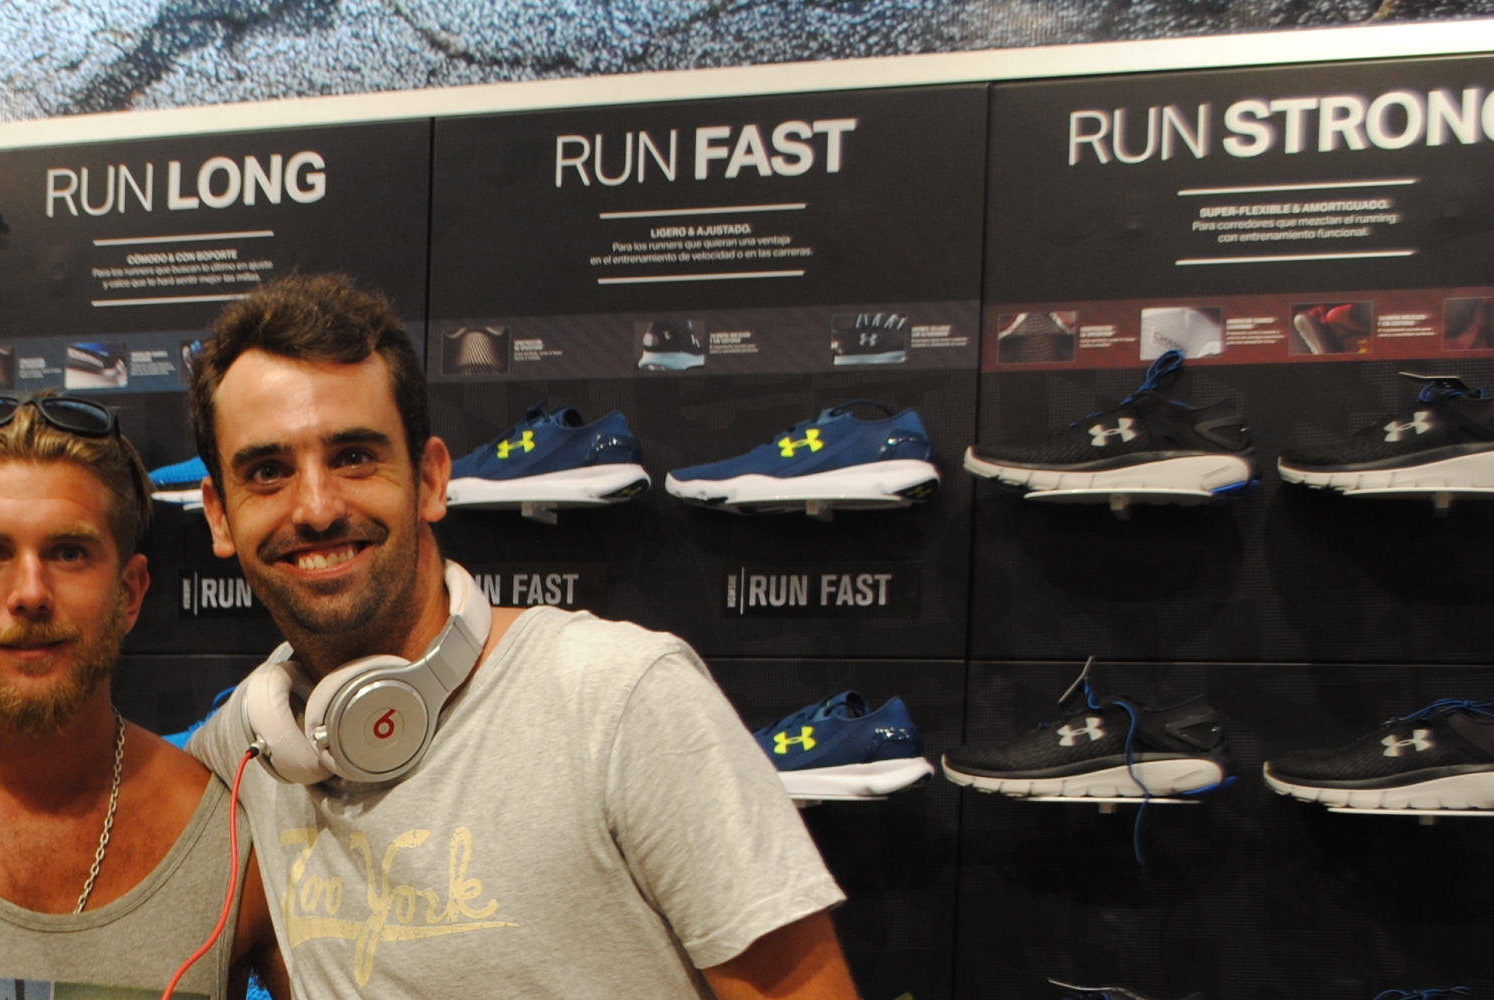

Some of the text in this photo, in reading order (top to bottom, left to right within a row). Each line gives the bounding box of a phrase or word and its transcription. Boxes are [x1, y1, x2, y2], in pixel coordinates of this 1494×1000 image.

[1067, 87, 1494, 167] RUN STRON
[554, 117, 857, 189] RUN FAST
[45, 150, 327, 218] RUN LONG
[1192, 213, 1397, 231] Para corredores que mezclan el running
[1199, 203, 1291, 218] SUPER-FLEXIBLE
[612, 235, 791, 253] Para los runners que quieran una ventaja
[650, 226, 686, 238] LIGERO
[1218, 233, 1238, 243] con
[1240, 230, 1316, 242] entrenamiento
[590, 255, 602, 266] en
[612, 252, 677, 265] entrenamiento
[678, 251, 690, 262] de
[691, 249, 735, 261] velocidad
[745, 249, 756, 260] en
[758, 247, 772, 258] las
[201, 577, 252, 609] RUN
[512, 573, 579, 605] FAST
[748, 573, 893, 607] RUN FAST
[350, 826, 499, 988] York
